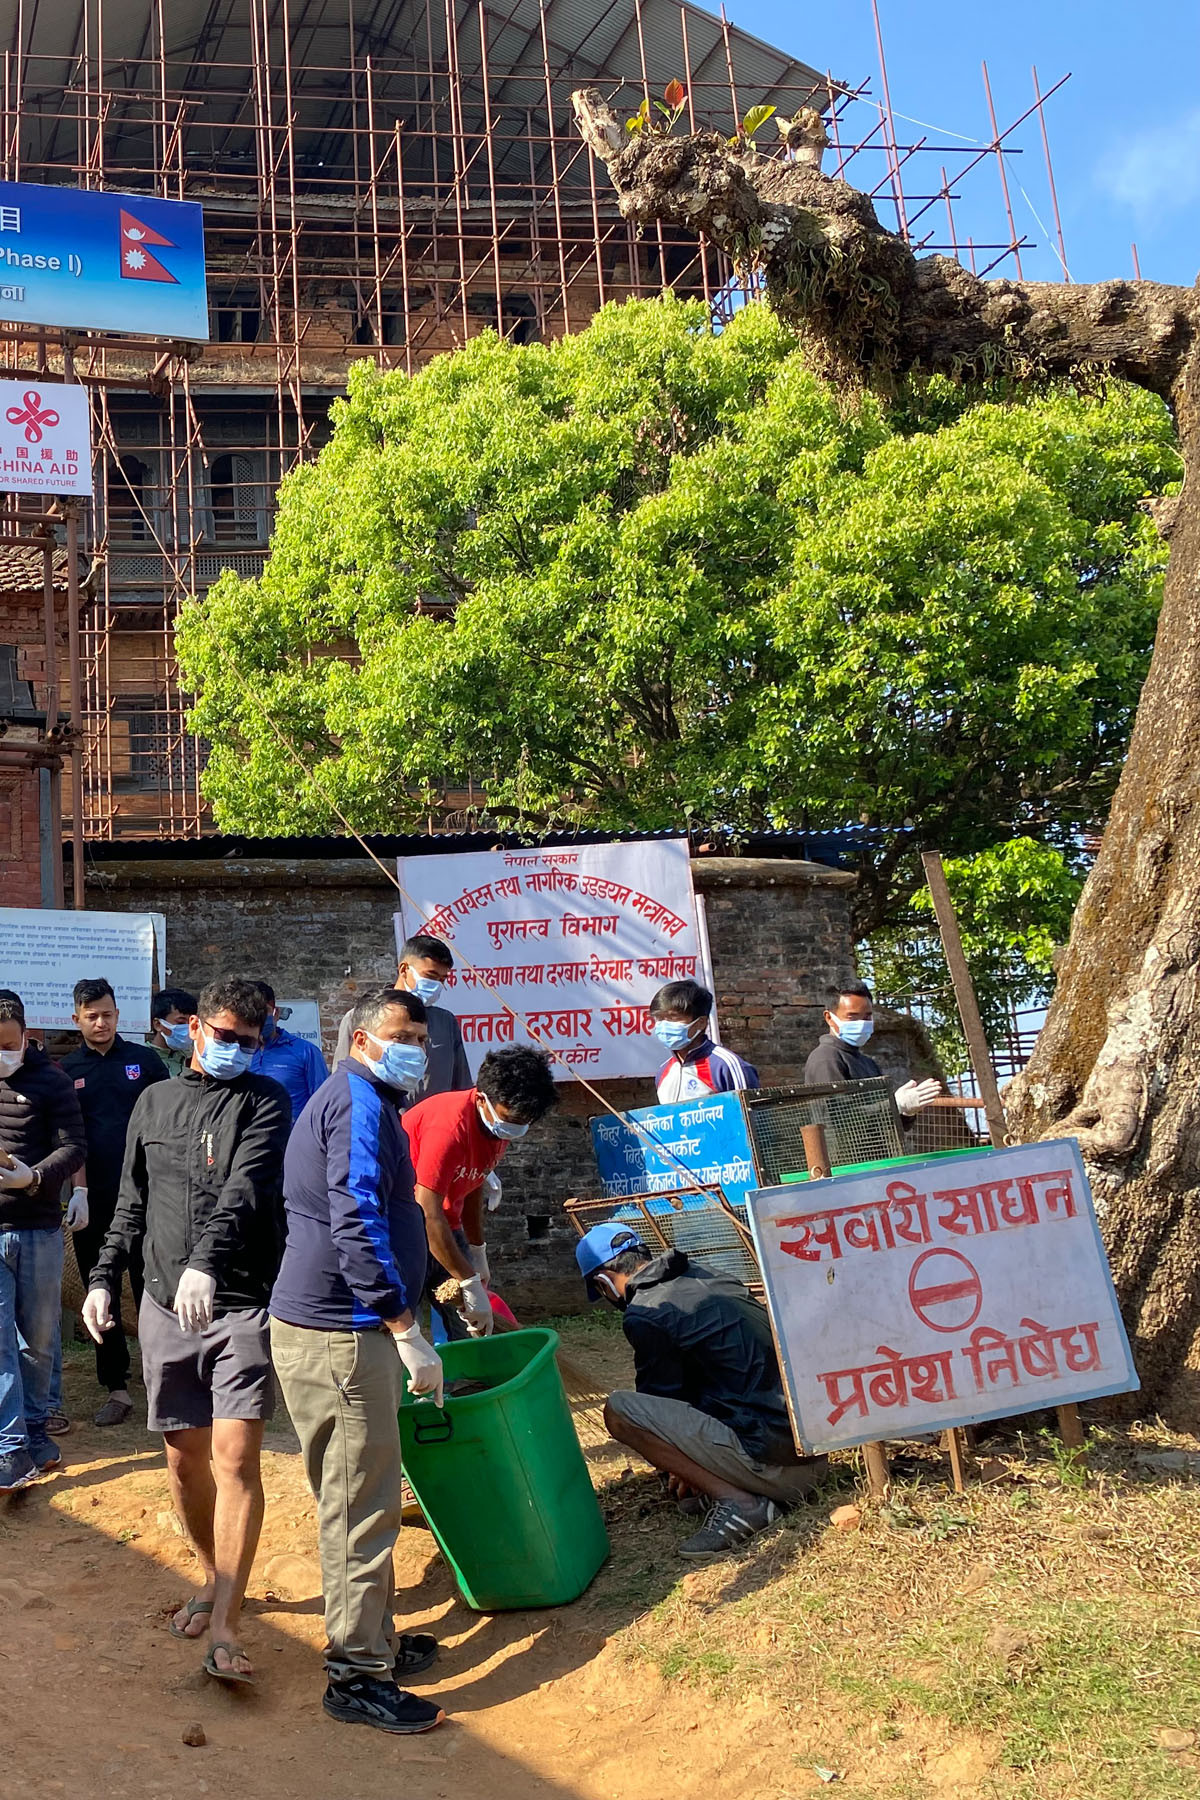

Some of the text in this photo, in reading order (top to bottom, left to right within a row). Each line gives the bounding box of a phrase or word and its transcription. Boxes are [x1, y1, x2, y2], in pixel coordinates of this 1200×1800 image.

[67, 254, 83, 278] I)
[11, 476, 44, 486] SHARED
[45, 479, 77, 487] FUTURE
[49, 463, 78, 476] AID
[503, 853, 579, 867] नेपाल सरकार
[453, 888, 495, 914] पर्यटन
[495, 876, 521, 900] तथा
[525, 867, 579, 895] नागरिक
[486, 912, 620, 950] पुरातत्व विभाग
[461, 964, 514, 991] संरक्षण
[515, 964, 545, 988] तथा
[547, 961, 589, 988] दरबार
[590, 953, 634, 987] हेरचाह
[636, 950, 697, 980] कार्यालय
[525, 1009, 592, 1043] दरबार
[679, 1102, 724, 1131] कार्यालय
[929, 1168, 1078, 1237] साधन
